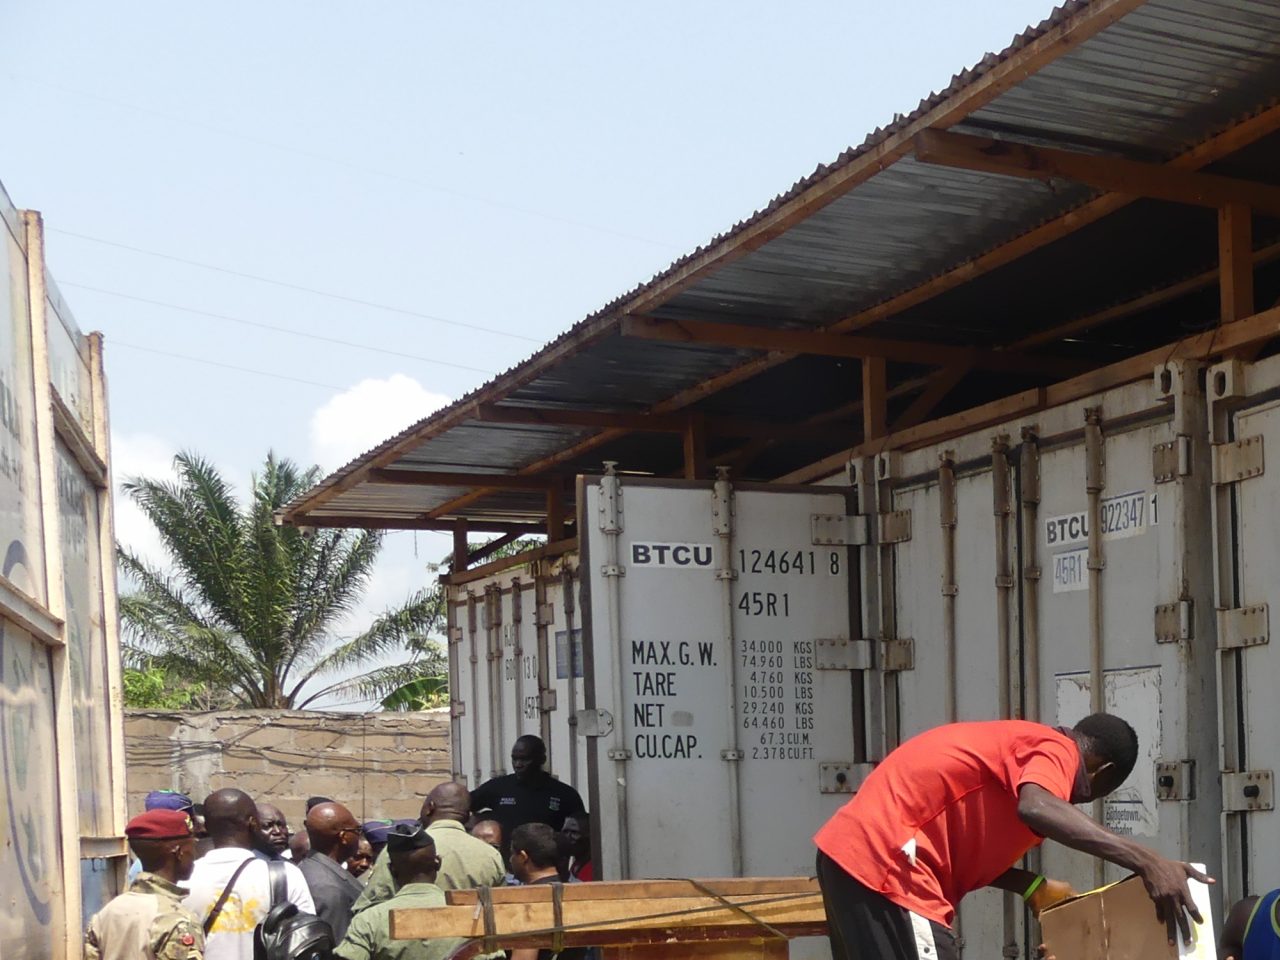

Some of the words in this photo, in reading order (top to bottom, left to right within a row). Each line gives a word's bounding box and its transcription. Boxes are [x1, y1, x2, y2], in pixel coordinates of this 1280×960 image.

[1101, 497, 1145, 534] 922347
[632, 544, 713, 566] BTCU
[740, 549, 816, 575] 124641
[829, 552, 840, 575] 8
[1055, 555, 1082, 584] 45R1
[738, 592, 790, 617] 45R1
[742, 640, 783, 654] 34.000
[793, 641, 813, 654] KGS
[742, 656, 783, 669] 74.960
[794, 656, 813, 670] LBS
[633, 672, 677, 697] TARE
[750, 671, 784, 685] 4.760
[794, 671, 813, 685] KGS
[744, 686, 784, 699] 10.500
[795, 687, 813, 700] LBS
[743, 701, 785, 715] 29.240
[795, 702, 814, 715] KGS
[634, 703, 664, 728] NET
[744, 716, 785, 730] 64.460
[796, 716, 814, 730] LBS
[760, 732, 785, 745] 67.3
[635, 734, 702, 759] CU.CAP.
[752, 747, 786, 760] 2.378
